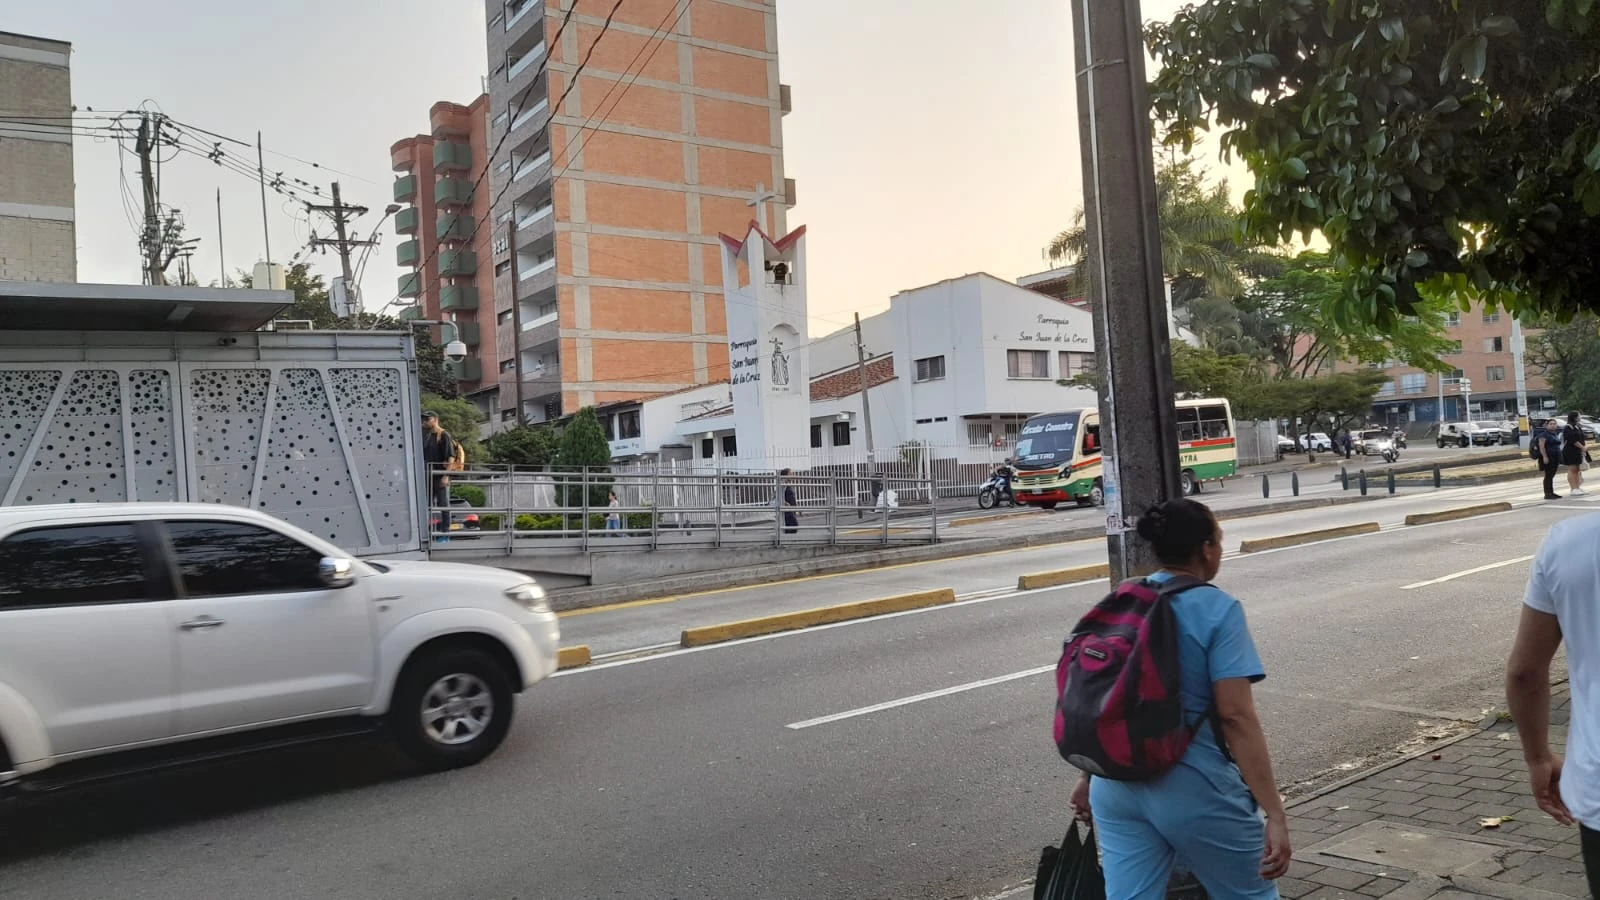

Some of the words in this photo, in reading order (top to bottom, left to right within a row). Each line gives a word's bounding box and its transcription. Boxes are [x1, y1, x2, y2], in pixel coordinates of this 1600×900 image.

[1037, 314, 1069, 329] Parroquia
[1019, 331, 1033, 341] San
[1035, 332, 1052, 341] Juan
[1055, 333, 1062, 342] de
[1072, 333, 1088, 343] Cruz
[731, 339, 757, 352] Parroquia
[732, 359, 744, 370] San
[745, 356, 759, 367] Juan
[732, 374, 739, 385] de
[740, 374, 746, 384] la
[746, 372, 760, 382] Cruz
